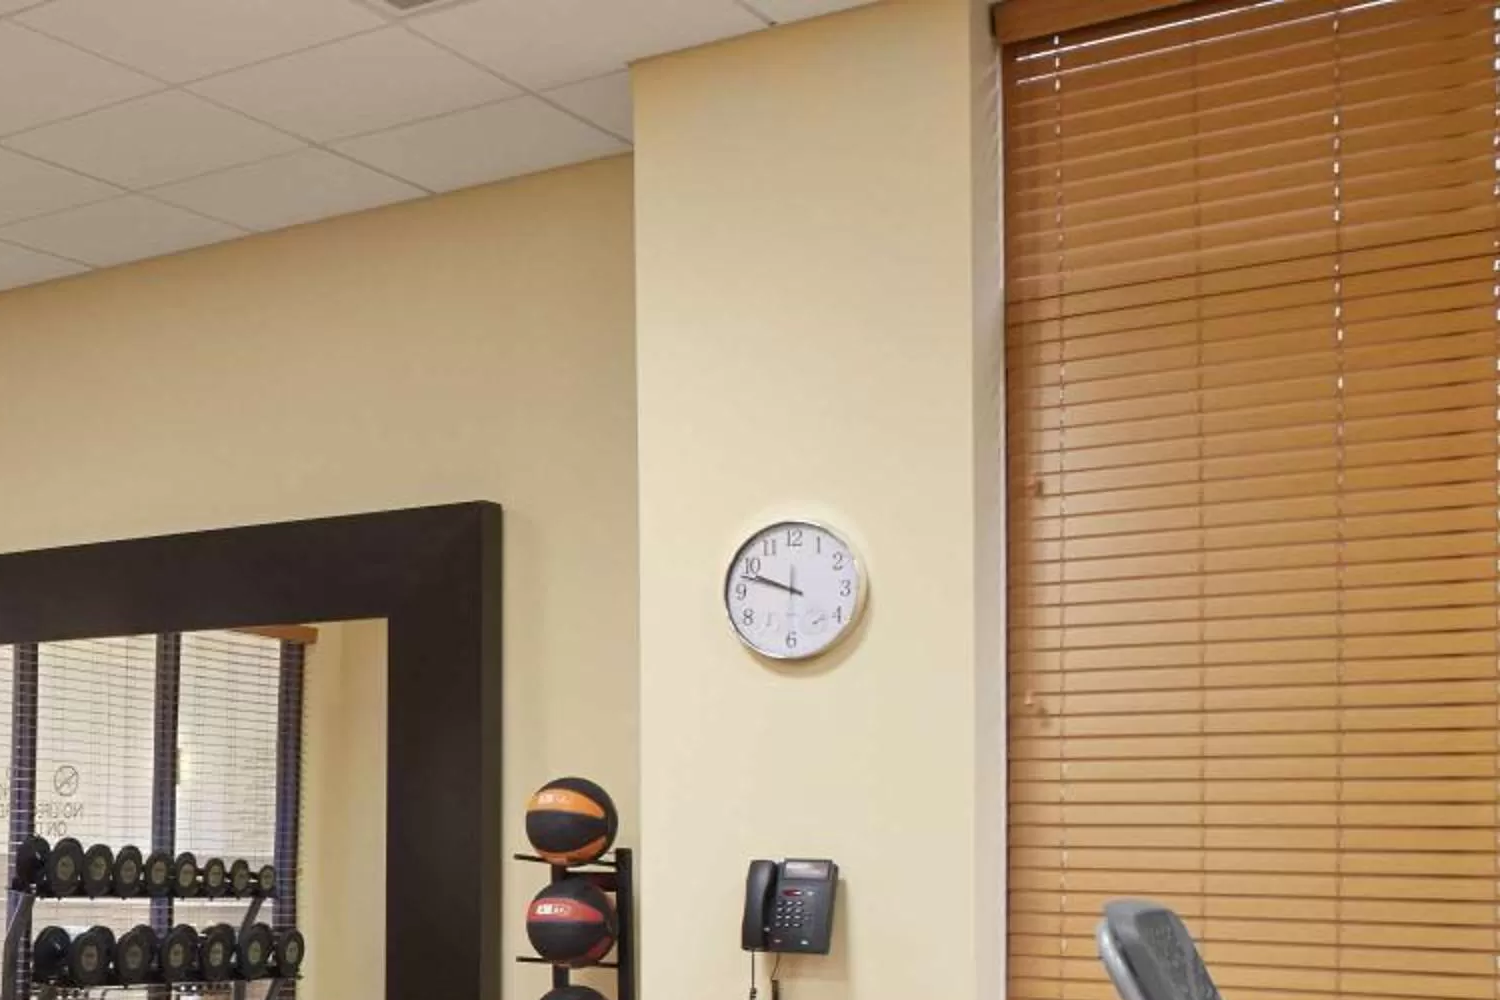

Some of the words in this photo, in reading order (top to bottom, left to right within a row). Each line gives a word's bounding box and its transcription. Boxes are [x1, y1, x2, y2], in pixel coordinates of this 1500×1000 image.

[786, 528, 803, 547] 12
[815, 536, 822, 554] 1
[763, 539, 777, 557] 11
[744, 557, 761, 575] 10
[832, 552, 843, 571] 2
[735, 583, 747, 601] 9
[839, 579, 851, 597] 3
[742, 608, 755, 626] 8
[831, 605, 843, 624] 4
[785, 631, 797, 649] 6
